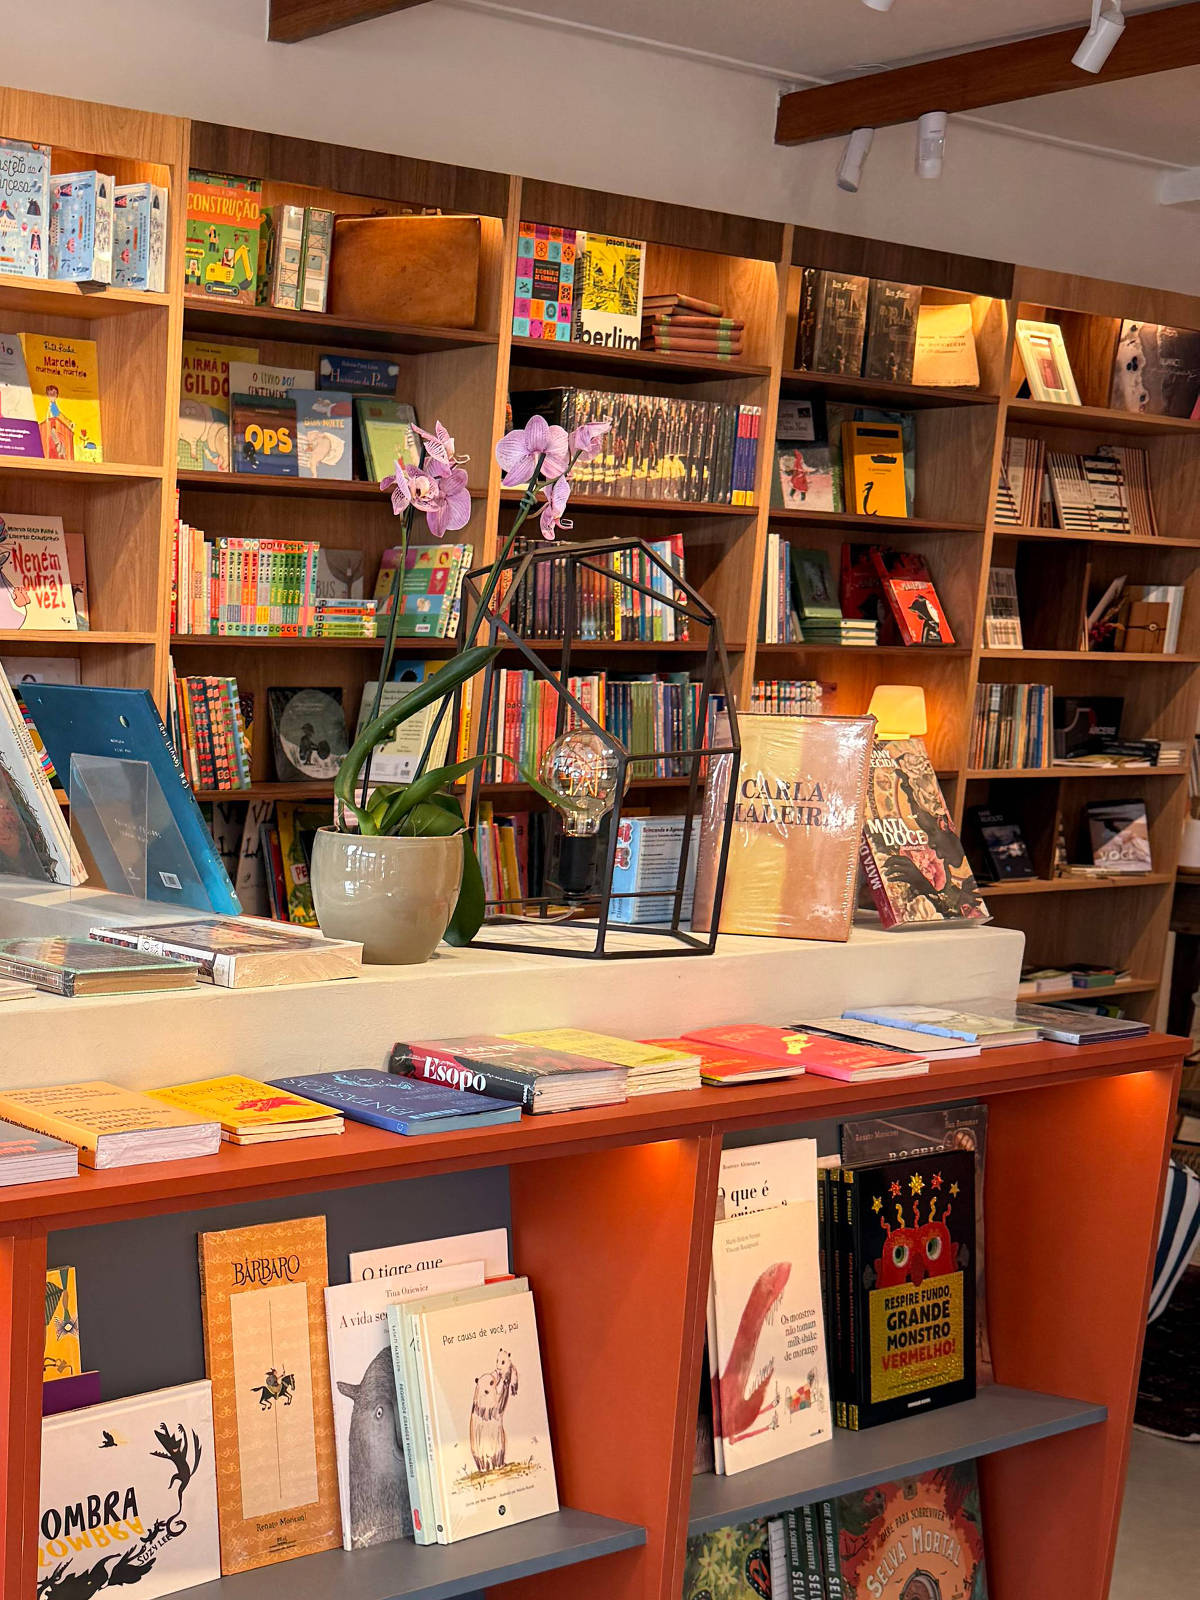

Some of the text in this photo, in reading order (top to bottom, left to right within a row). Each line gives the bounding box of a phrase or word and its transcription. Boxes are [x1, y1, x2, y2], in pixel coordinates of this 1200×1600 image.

[186, 191, 259, 222] CONSTRUÇÃO
[579, 321, 640, 351] berlim
[184, 373, 230, 398] GILDO
[245, 424, 293, 455] OPS
[11, 543, 62, 575] Neném
[22, 571, 58, 592] outra
[741, 779, 825, 803] CARLA
[866, 818, 910, 834] MATA
[881, 829, 929, 847] DOCE
[423, 1056, 487, 1092] Esopo
[730, 1179, 770, 1207] que é
[231, 1253, 301, 1287] BÁRBARO
[361, 1266, 375, 1280] O
[385, 1287, 400, 1299] Tina
[884, 1285, 952, 1311] RESPIRE FUNDO,
[339, 1310, 373, 1328] A vida
[780, 1308, 816, 1325] Os monstros
[785, 1324, 796, 1335] não
[886, 1300, 951, 1332] GRANDE
[442, 1333, 456, 1346] Por
[457, 1331, 478, 1344] causa
[478, 1328, 489, 1341] de
[508, 1321, 520, 1332] pai
[886, 1321, 951, 1352] MONSTRO
[784, 1344, 818, 1362] de morango
[881, 1338, 957, 1372] VERMELHO!
[40, 1486, 140, 1540] OMBRA
[136, 1533, 173, 1565] SUZY LEE
[866, 1525, 961, 1599] SELVA MORTAL
